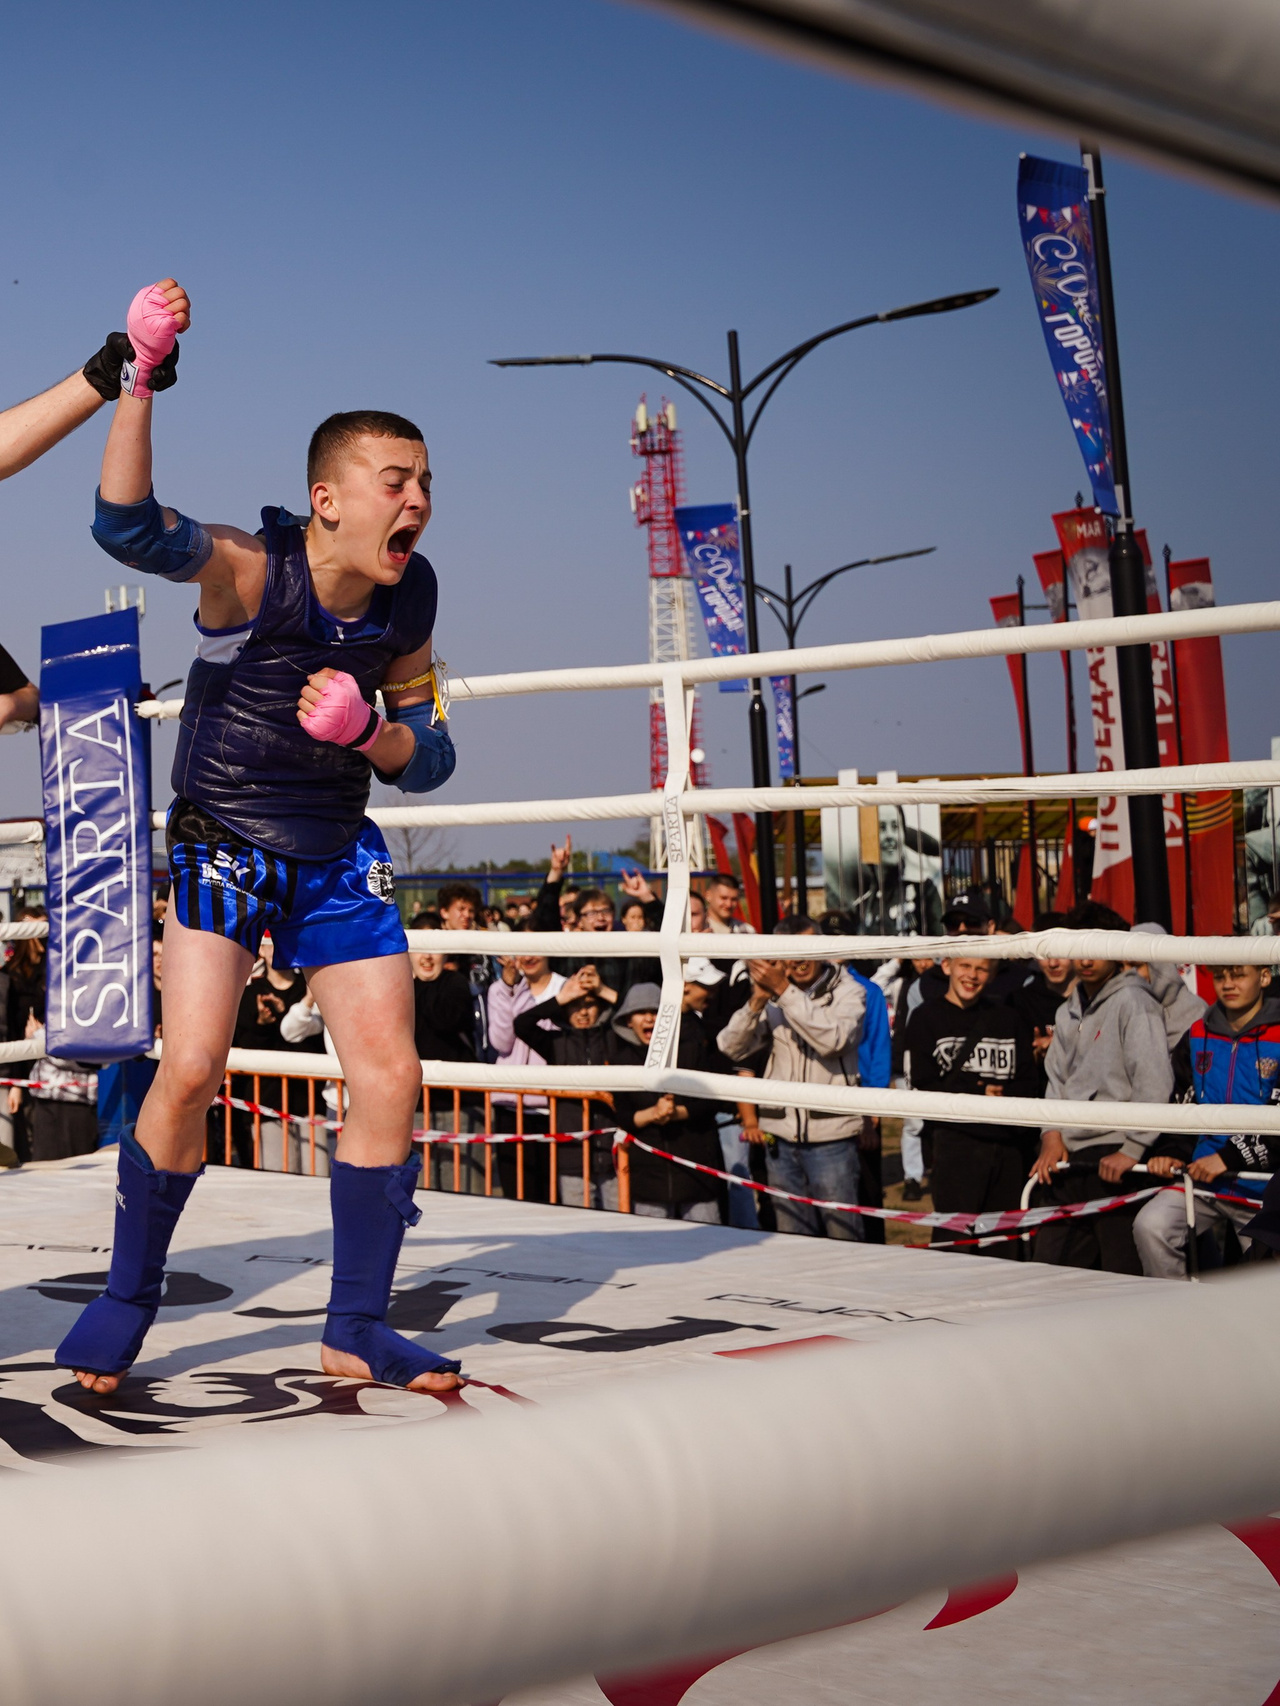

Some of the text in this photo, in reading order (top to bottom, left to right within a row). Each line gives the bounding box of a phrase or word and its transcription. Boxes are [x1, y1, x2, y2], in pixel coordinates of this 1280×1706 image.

[665, 795, 684, 863] SPARTA
[65, 699, 130, 1028] SPARTA
[648, 1003, 677, 1069] SPARTA
